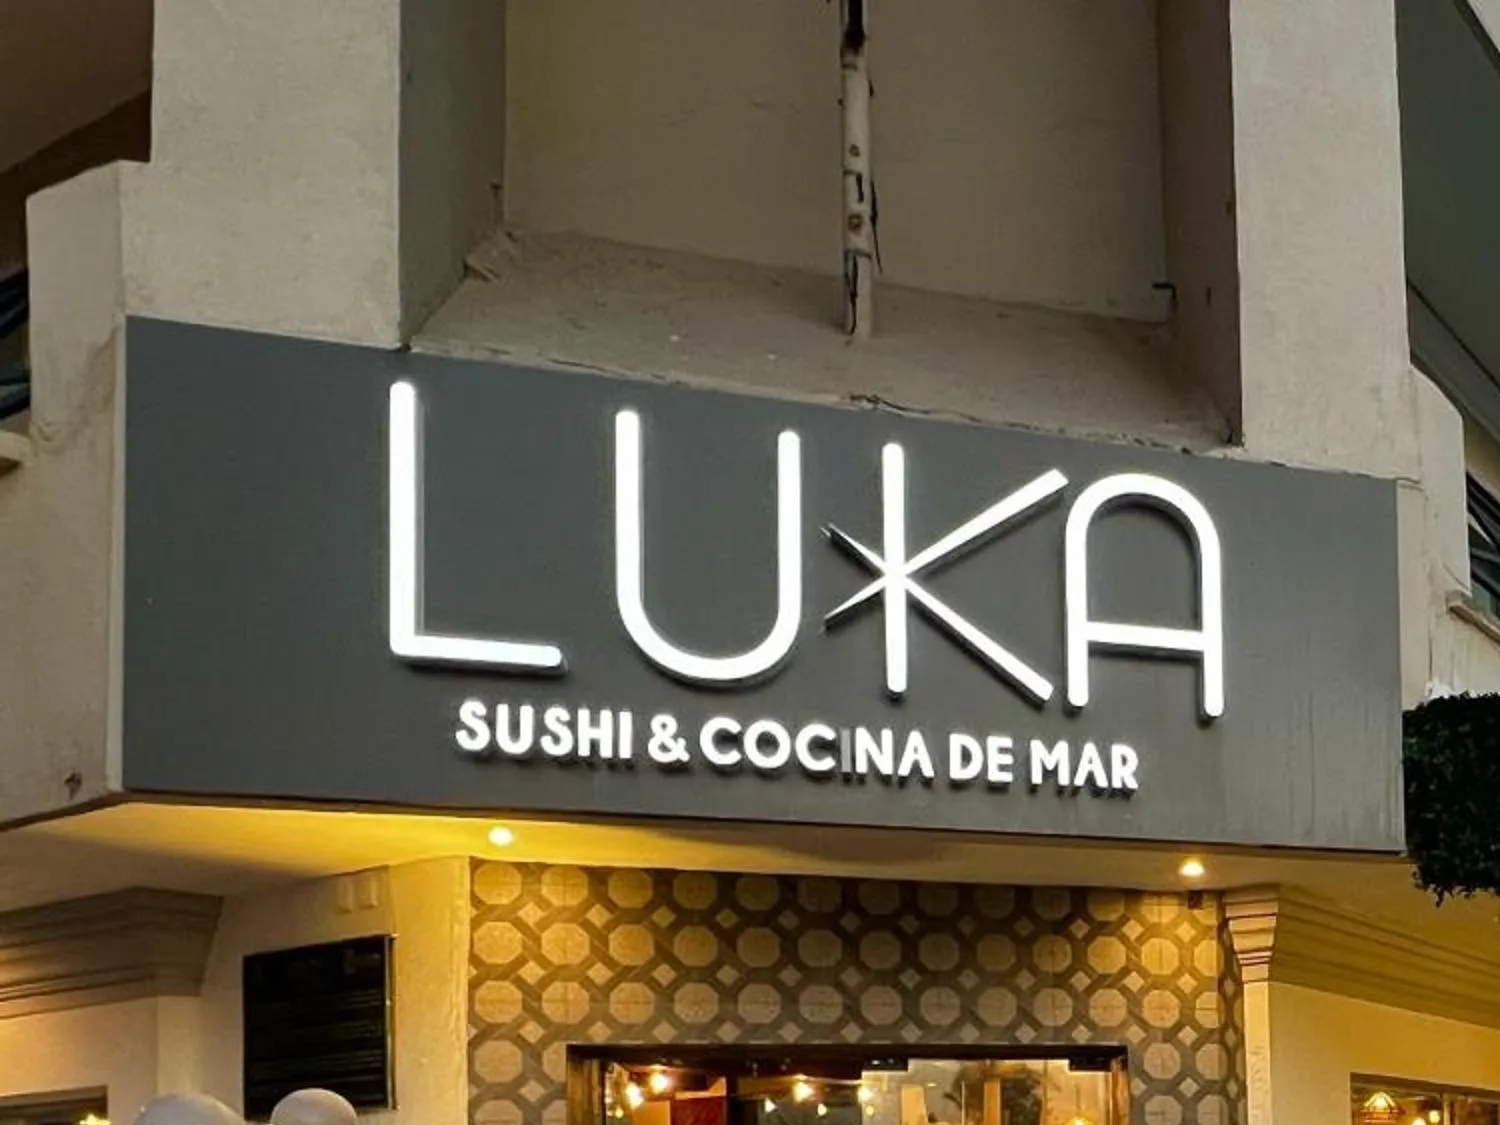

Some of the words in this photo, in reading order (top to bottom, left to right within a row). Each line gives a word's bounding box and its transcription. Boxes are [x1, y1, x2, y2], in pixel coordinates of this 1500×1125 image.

[388, 380, 1225, 718] LUKA
[454, 698, 634, 760] SUSHI
[646, 712, 690, 764] &
[699, 715, 935, 782] COCINA
[949, 733, 1015, 784] DE
[1030, 738, 1141, 791] MAR
